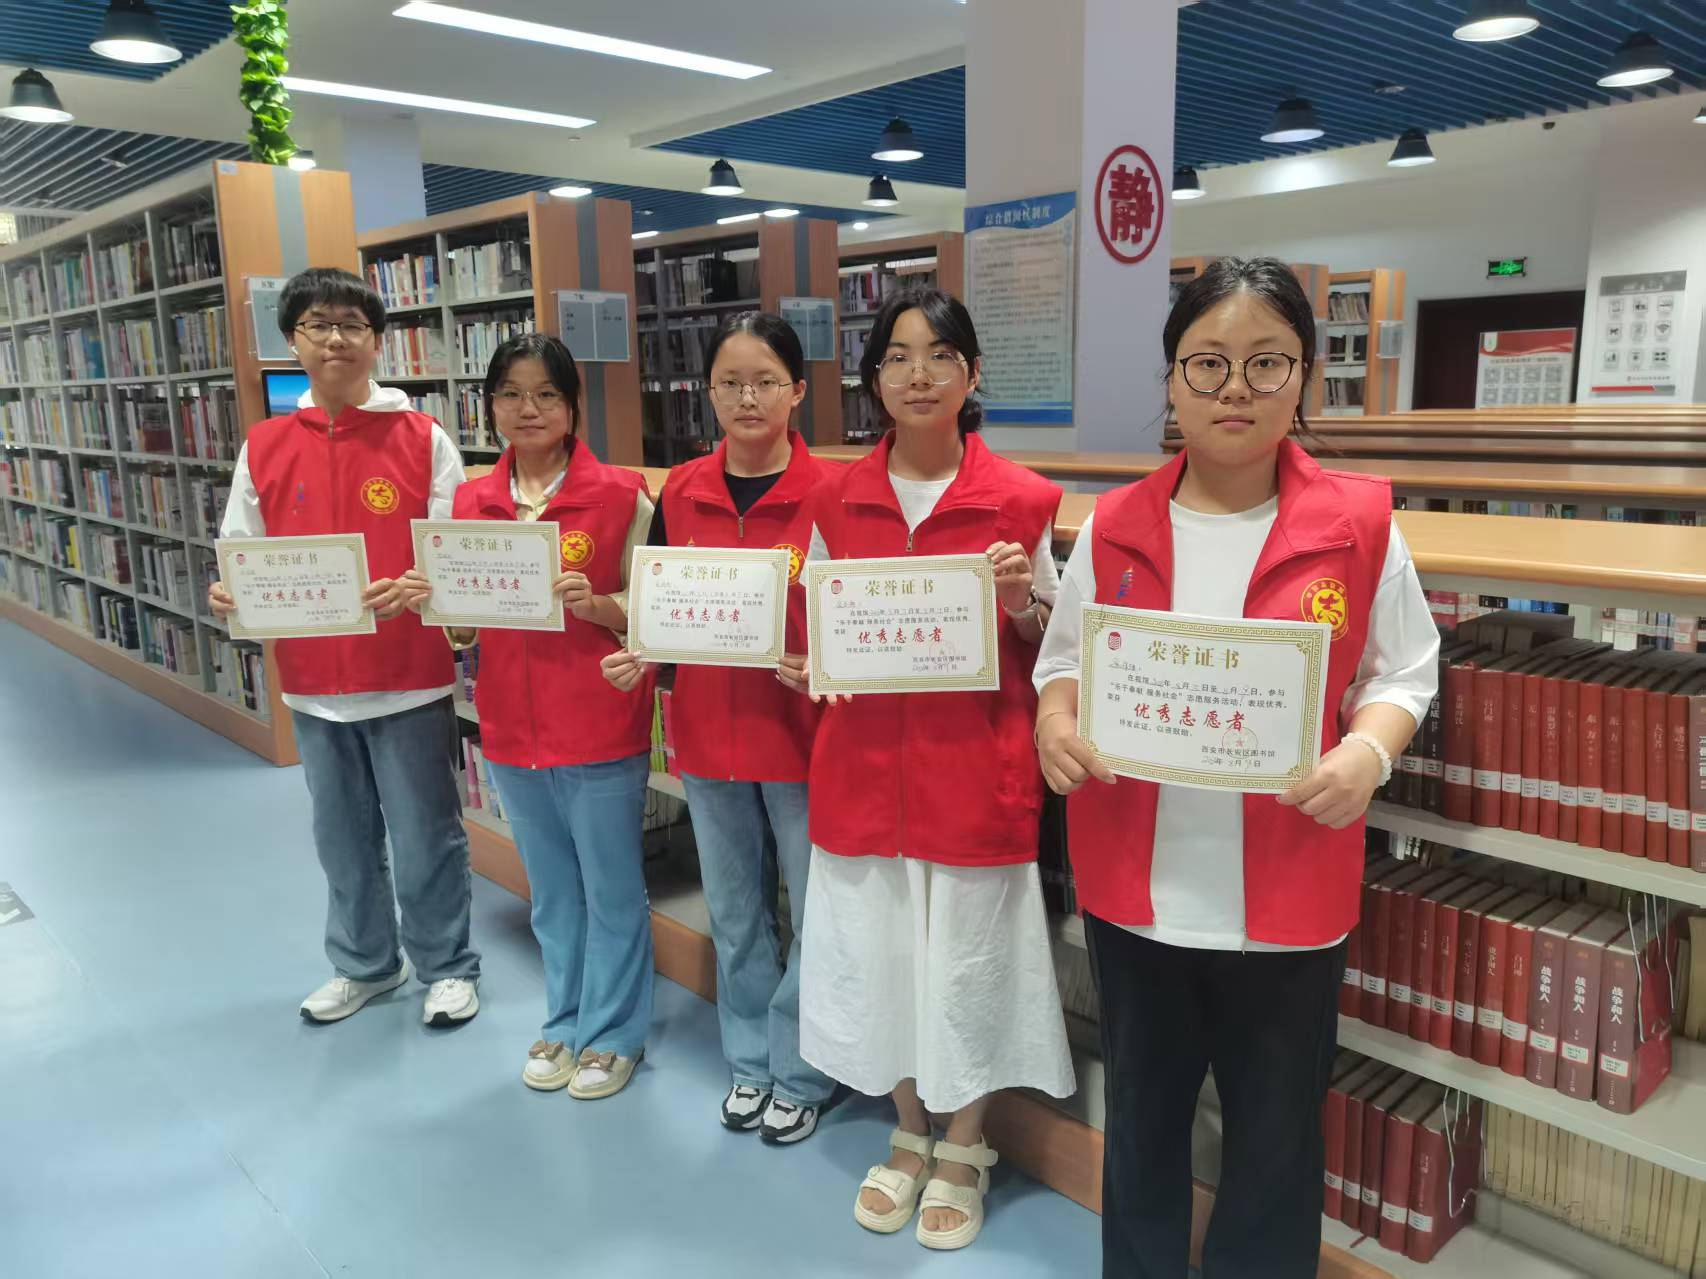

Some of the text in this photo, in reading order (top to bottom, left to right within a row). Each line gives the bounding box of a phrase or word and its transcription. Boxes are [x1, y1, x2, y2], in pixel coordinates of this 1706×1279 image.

[1108, 164, 1155, 244] 静
[459, 537, 513, 552] 荣誉证书
[263, 552, 320, 567] 荣誉证书
[680, 564, 740, 581] 荣誉证书
[456, 576, 521, 591] 优秀志愿者
[865, 578, 935, 597] 荣誉证书
[262, 588, 328, 603] 优秀志愿者
[670, 606, 741, 623] 优秀志愿者
[857, 626, 944, 645] 优秀志愿者
[1147, 639, 1241, 670] 荣誉证书
[1134, 703, 1247, 732] 优秀志愿者
[1539, 966, 1553, 1004] 战争和人
[1573, 976, 1586, 1014] 战争和人
[1611, 986, 1624, 1025] 战争和人
